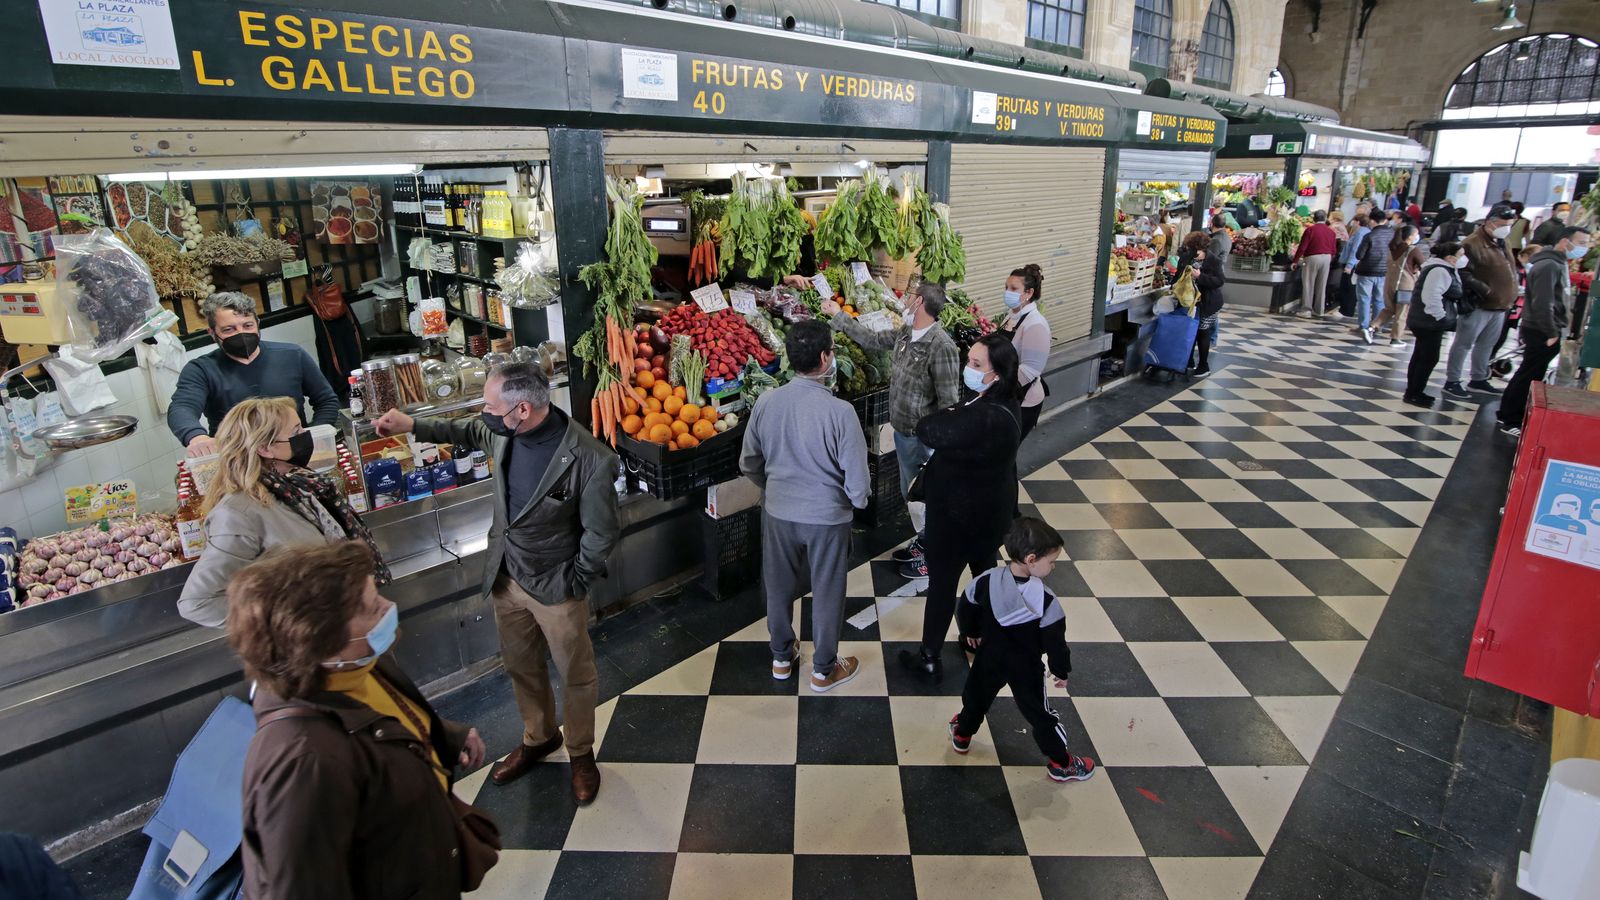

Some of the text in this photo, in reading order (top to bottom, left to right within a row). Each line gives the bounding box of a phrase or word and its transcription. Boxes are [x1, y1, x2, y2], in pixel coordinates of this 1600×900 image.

[78, 0, 135, 14] LA PLAZA
[102, 14, 134, 23] PLAZA
[238, 10, 474, 64] ESPECIAS
[58, 51, 175, 66] LOCAL ASOCIADO
[191, 50, 475, 99] L. GALLEGO
[692, 59, 915, 102] FRUTAS Y VERDURAS
[693, 90, 726, 115] 40
[996, 95, 1105, 121] FRUTAS Y VERDURAS
[996, 114, 1104, 137] 39 V. TINOCO
[1152, 113, 1216, 131] FRUTAS Y VERDURAS
[1183, 130, 1215, 144] GRANADOS
[1563, 471, 1575, 479] LA
[1576, 474, 1600, 483] MASC
[99, 482, 128, 495] Ajos
